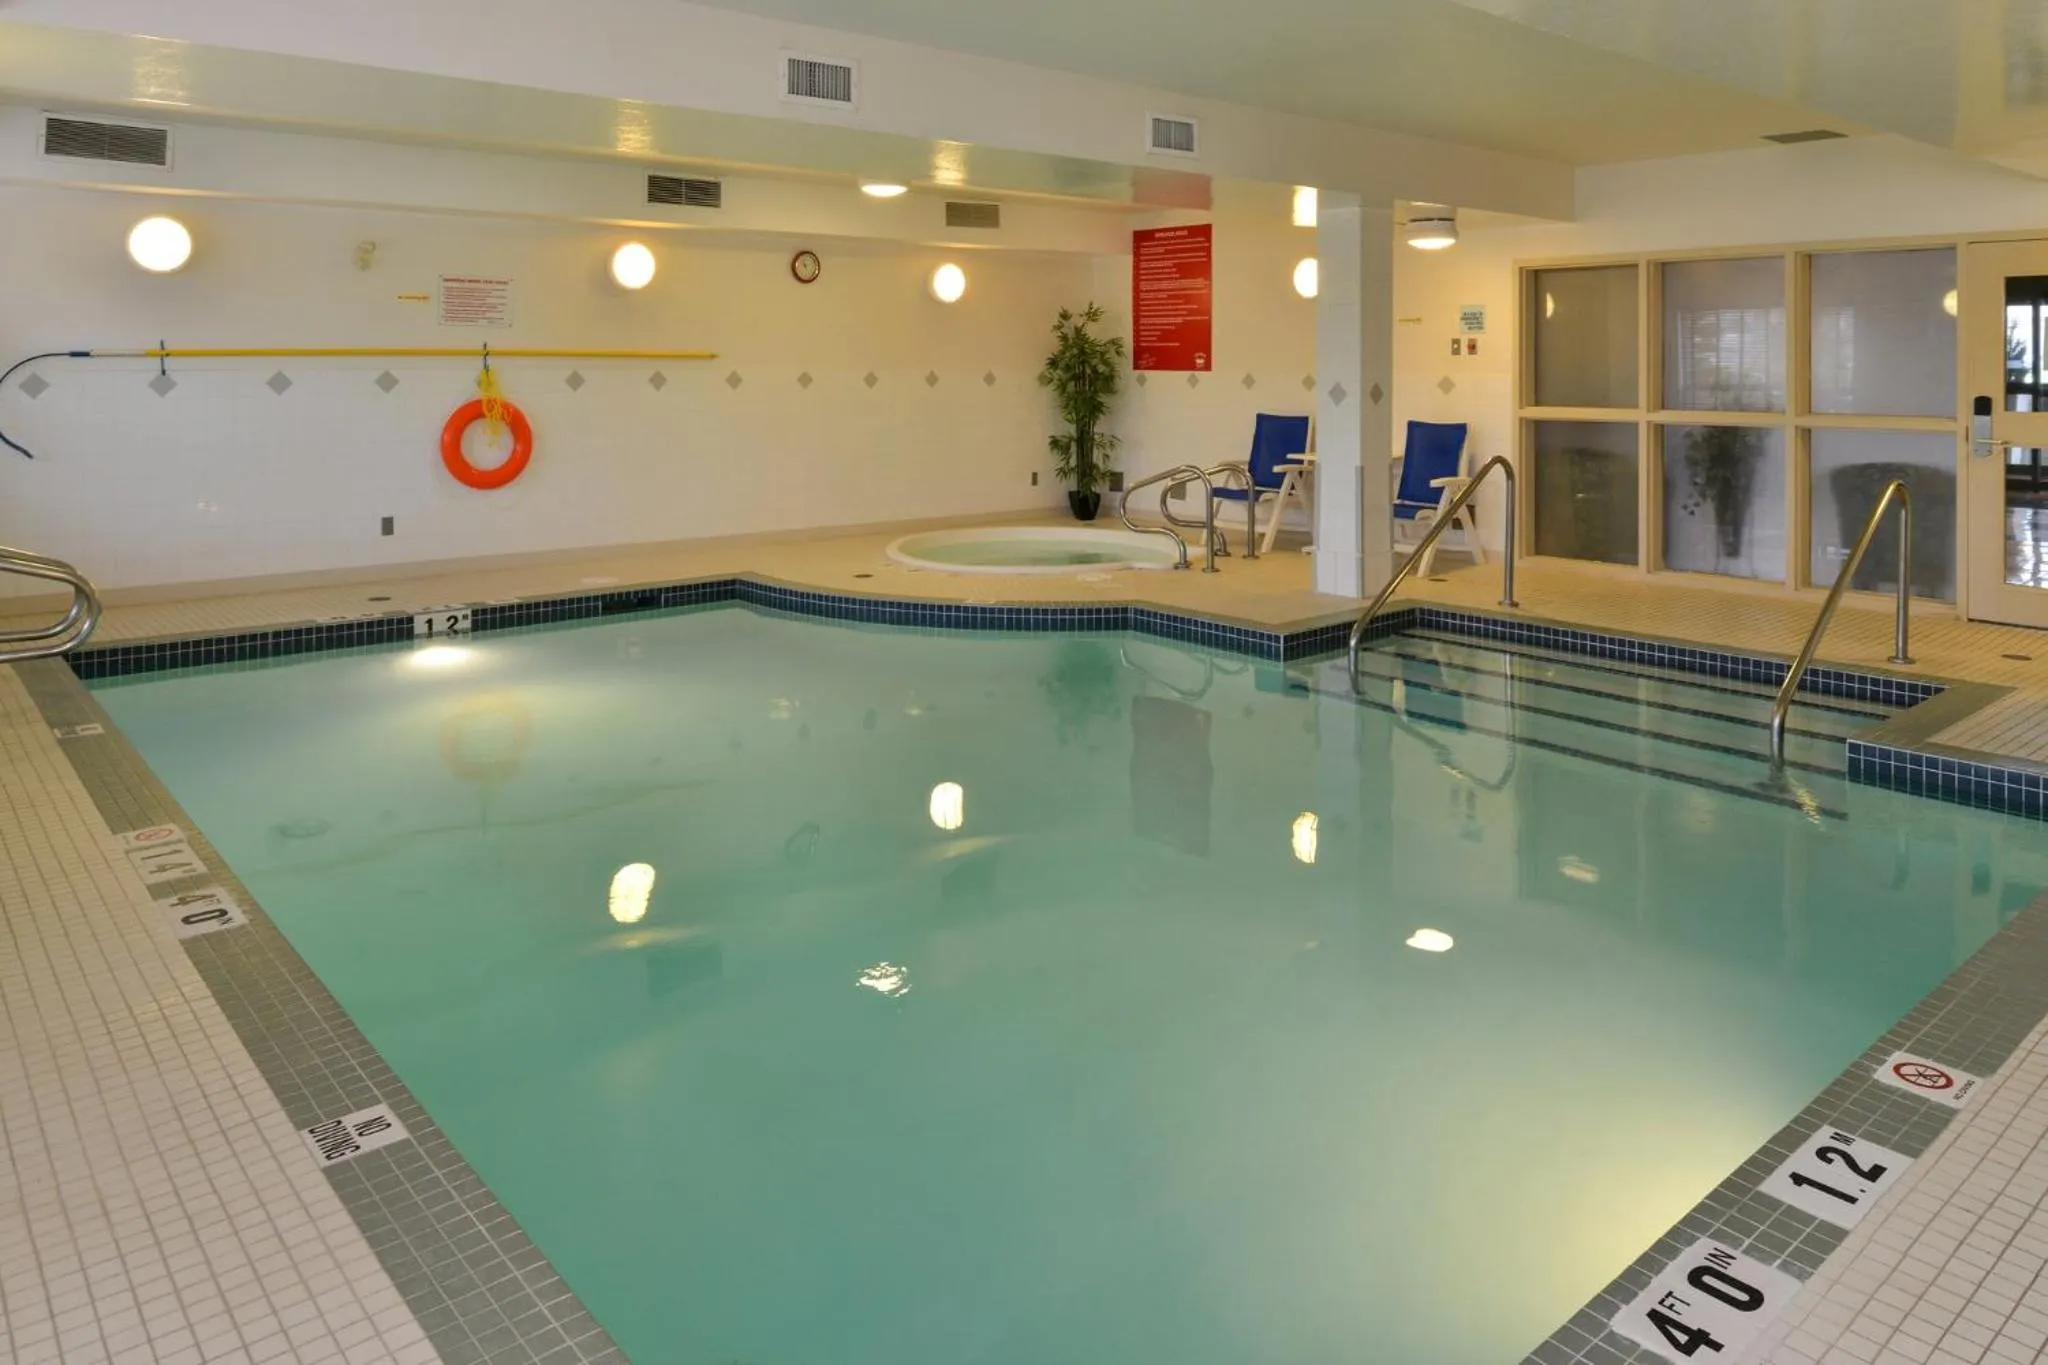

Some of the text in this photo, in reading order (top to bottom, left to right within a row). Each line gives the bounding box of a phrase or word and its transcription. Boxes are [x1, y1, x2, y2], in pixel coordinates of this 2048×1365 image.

[307, 1119, 361, 1161] DIVING
[352, 1114, 393, 1137] NO
[1788, 1131, 1889, 1206] 1.2 M
[1645, 1246, 1766, 1358] 4 FT 0 IN
